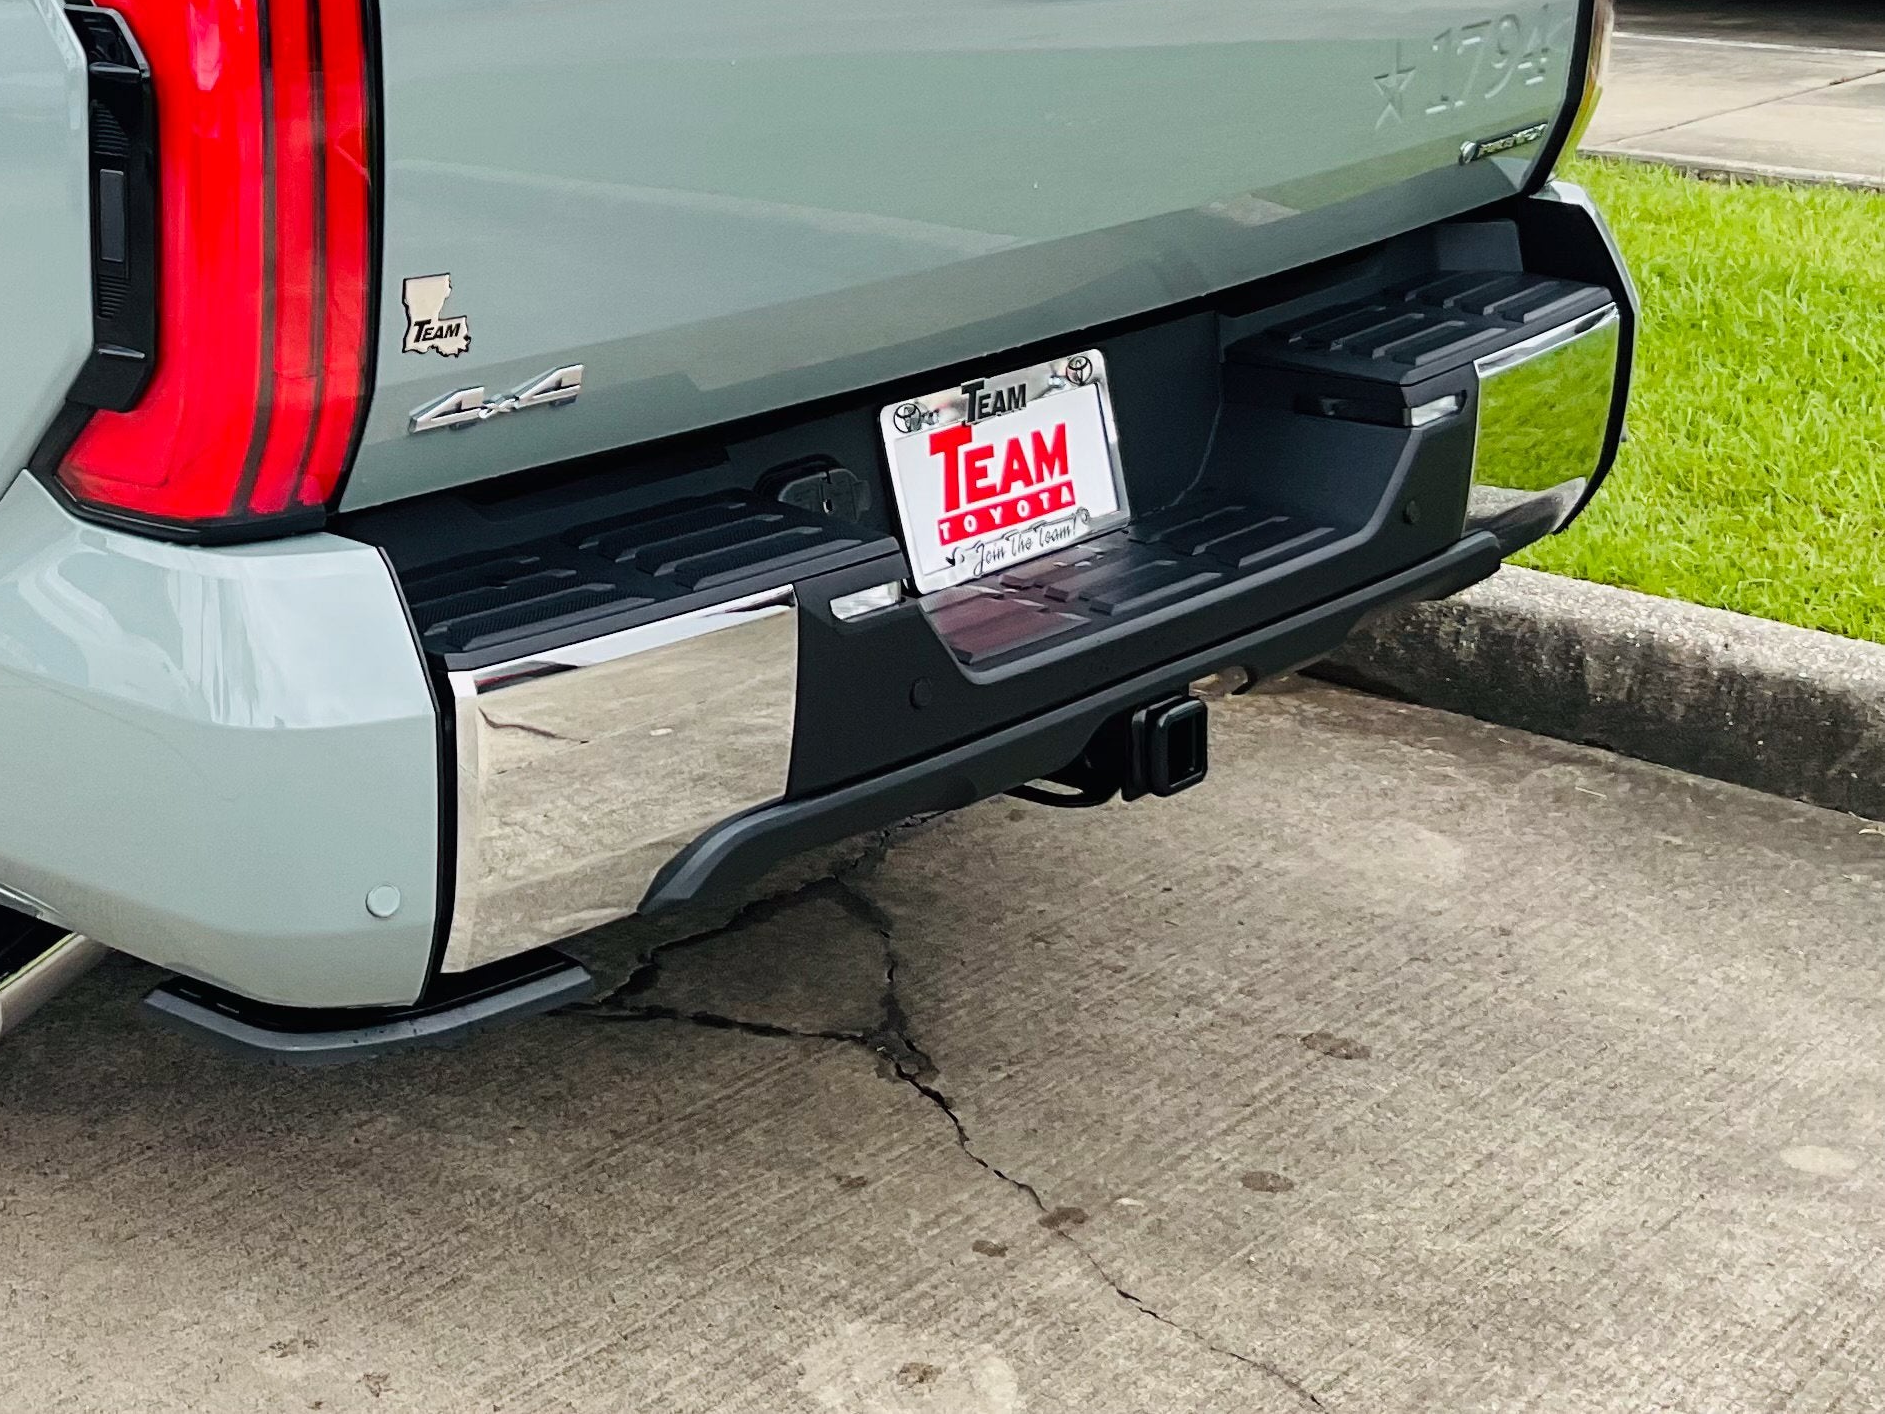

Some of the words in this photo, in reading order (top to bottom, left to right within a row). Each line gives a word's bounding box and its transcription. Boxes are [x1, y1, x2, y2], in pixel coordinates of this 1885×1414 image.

[413, 319, 461, 343] TEAM
[961, 379, 1027, 424] TEAM
[929, 423, 1069, 512] TEAM
[939, 489, 1073, 540] TOYOTA
[974, 539, 1005, 577] Join
[1004, 530, 1033, 557] The
